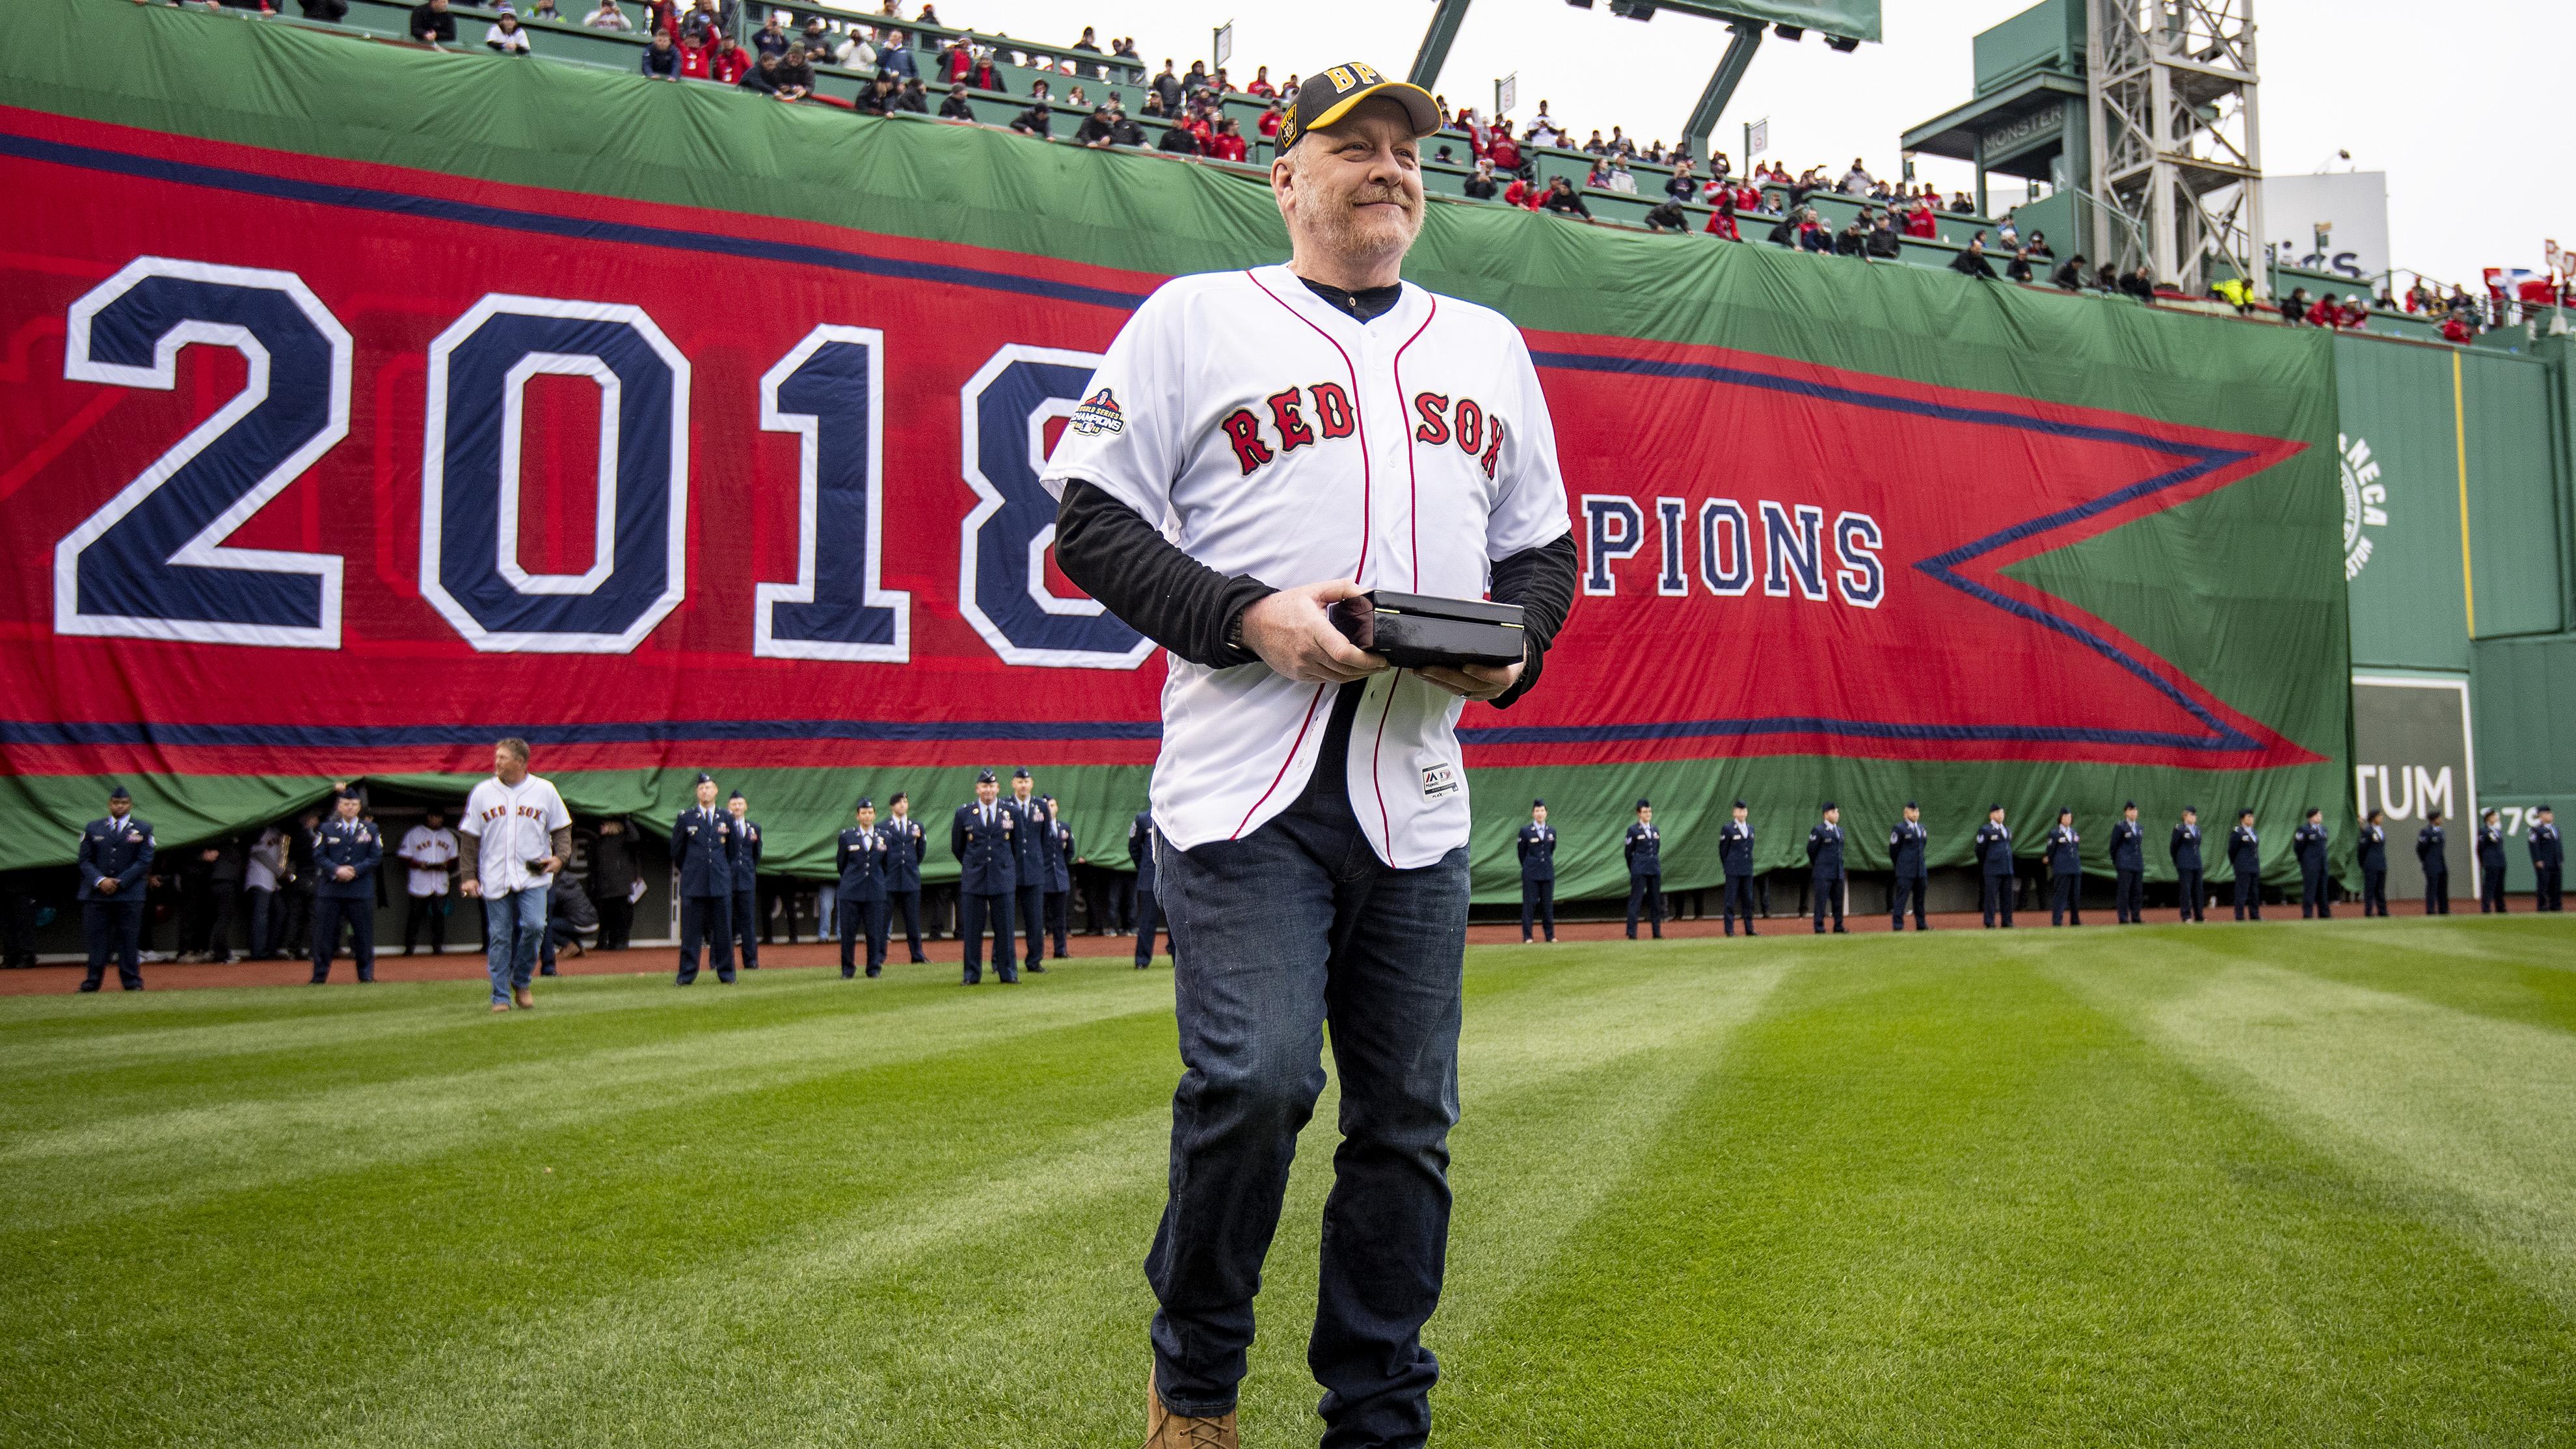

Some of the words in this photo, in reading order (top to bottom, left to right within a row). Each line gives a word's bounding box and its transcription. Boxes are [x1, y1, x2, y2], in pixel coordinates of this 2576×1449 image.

[1323, 63, 1376, 94] BP
[1983, 105, 2062, 152] MONSTER
[1071, 412, 1122, 431] CHAMPIONS
[1095, 408, 1120, 420] SERIES
[1220, 381, 1358, 477] RED
[1414, 391, 1504, 481] SOX
[54, 254, 1162, 671] 2018
[1581, 494, 1885, 609] PIONS
[482, 805, 506, 823] RED
[517, 805, 542, 821] SOX
[2356, 765, 2453, 820] TUM
